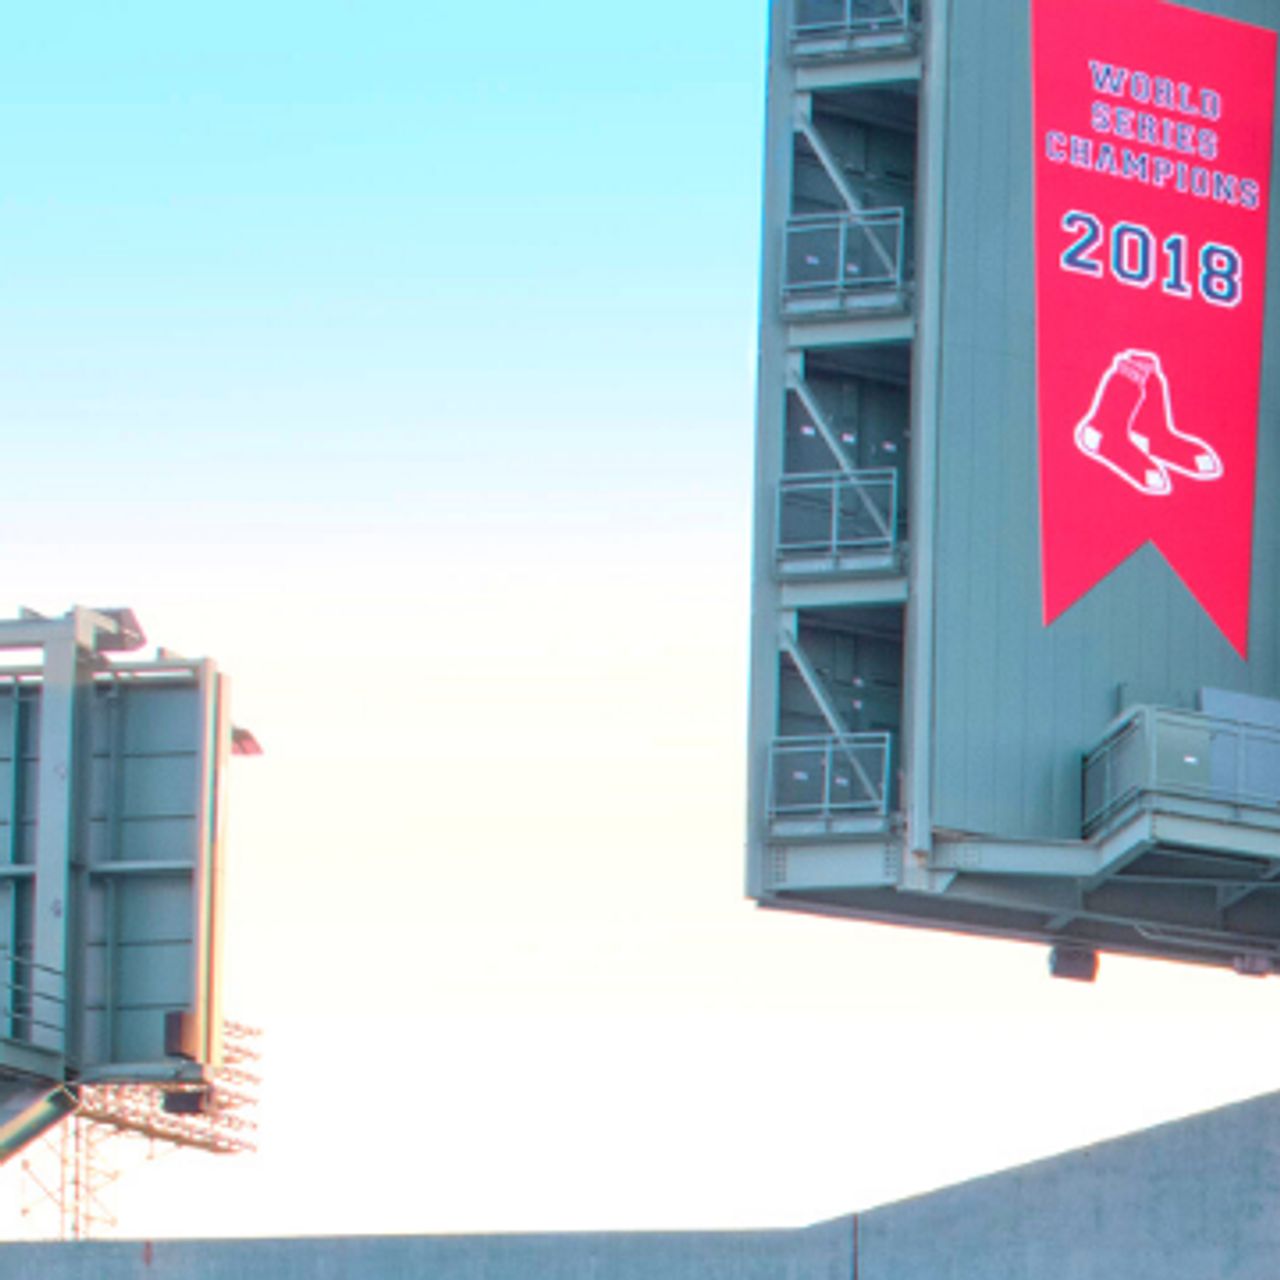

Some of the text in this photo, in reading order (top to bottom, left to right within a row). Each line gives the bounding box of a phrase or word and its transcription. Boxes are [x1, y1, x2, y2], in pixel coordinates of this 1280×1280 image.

[1088, 59, 1222, 121] WORLD
[1090, 99, 1218, 160] SERIES
[1045, 130, 1261, 211] CHAMPIONS
[1059, 208, 1243, 309] 2018
